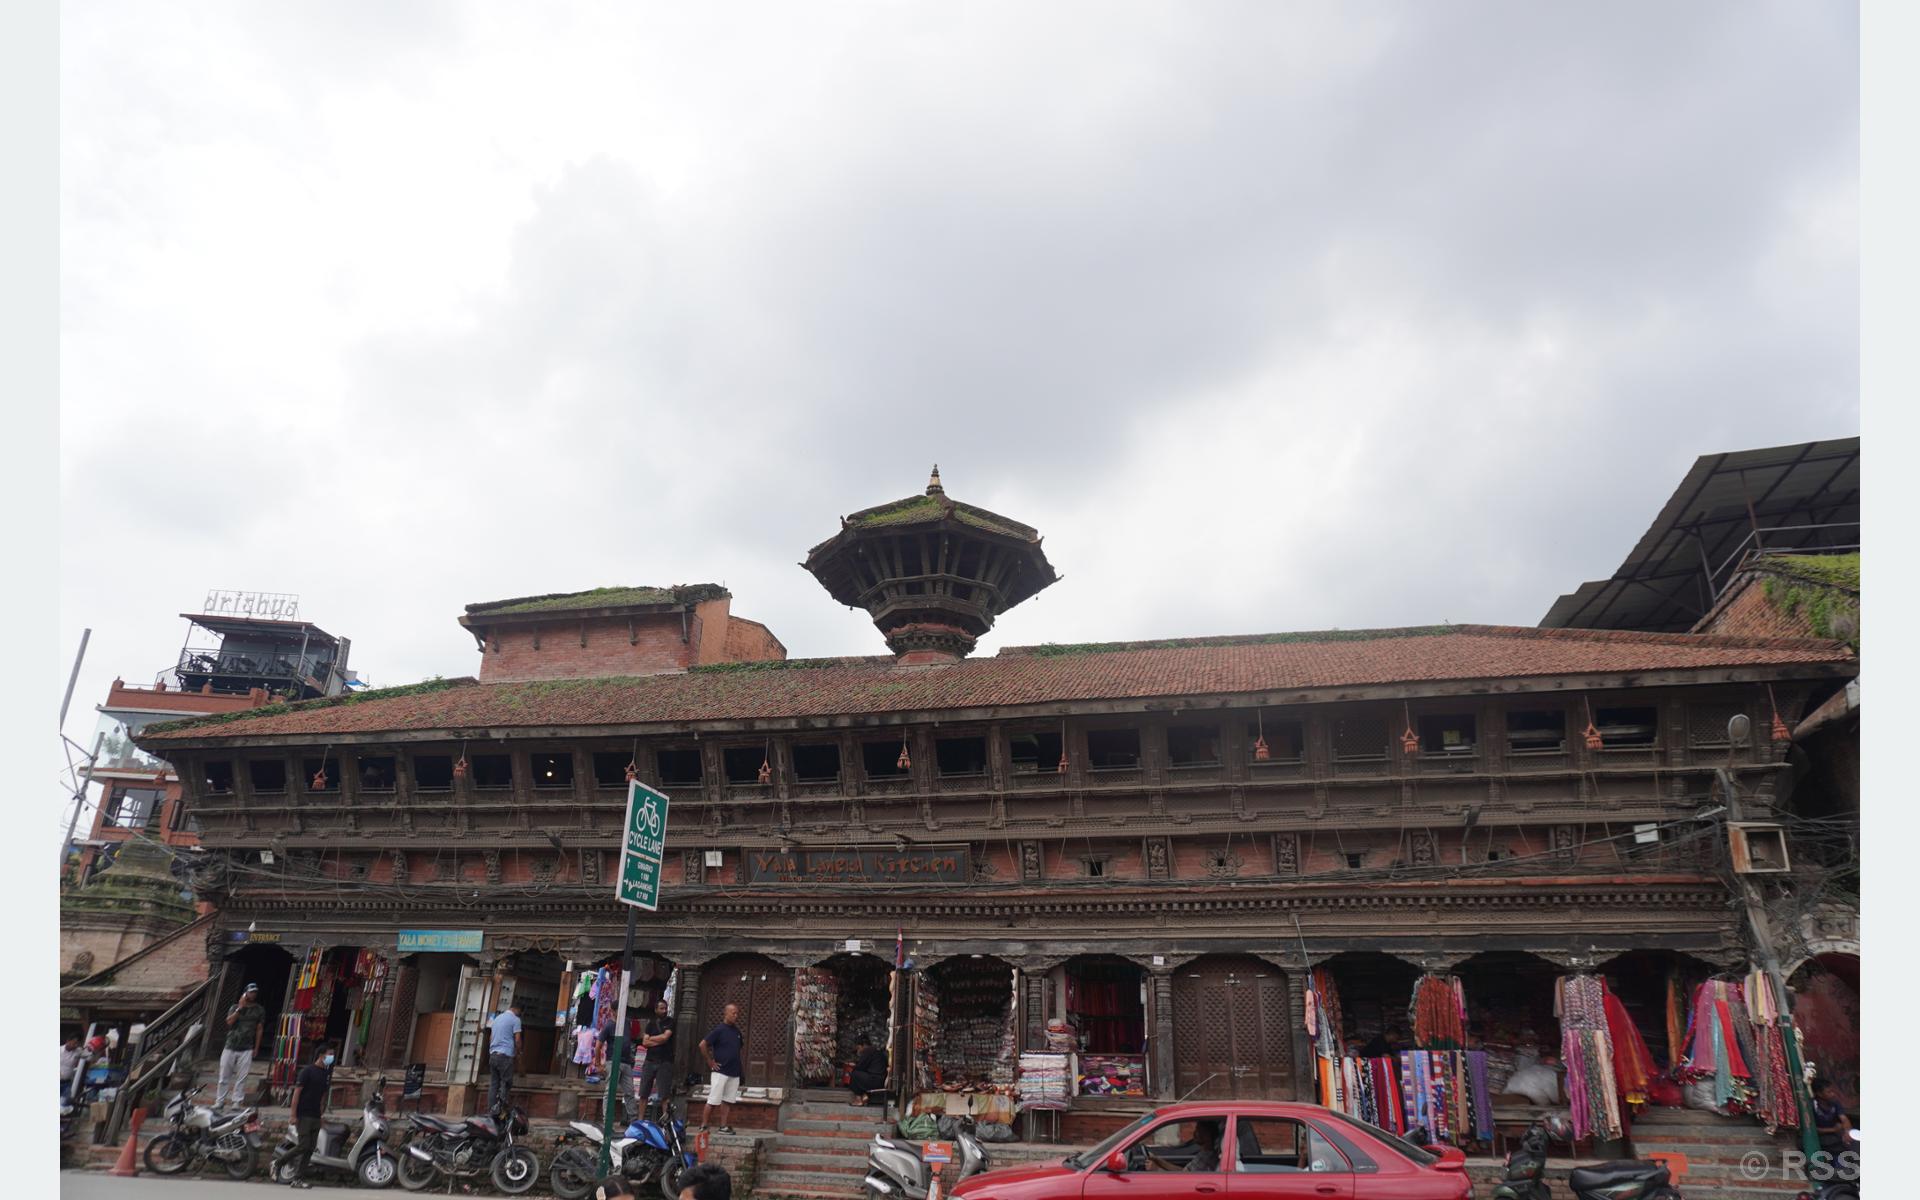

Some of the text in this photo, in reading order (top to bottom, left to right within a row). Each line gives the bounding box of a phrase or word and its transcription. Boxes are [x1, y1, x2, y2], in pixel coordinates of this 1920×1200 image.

[628, 831, 661, 855] CYCLE LANE
[874, 855, 958, 873] Kitchen
